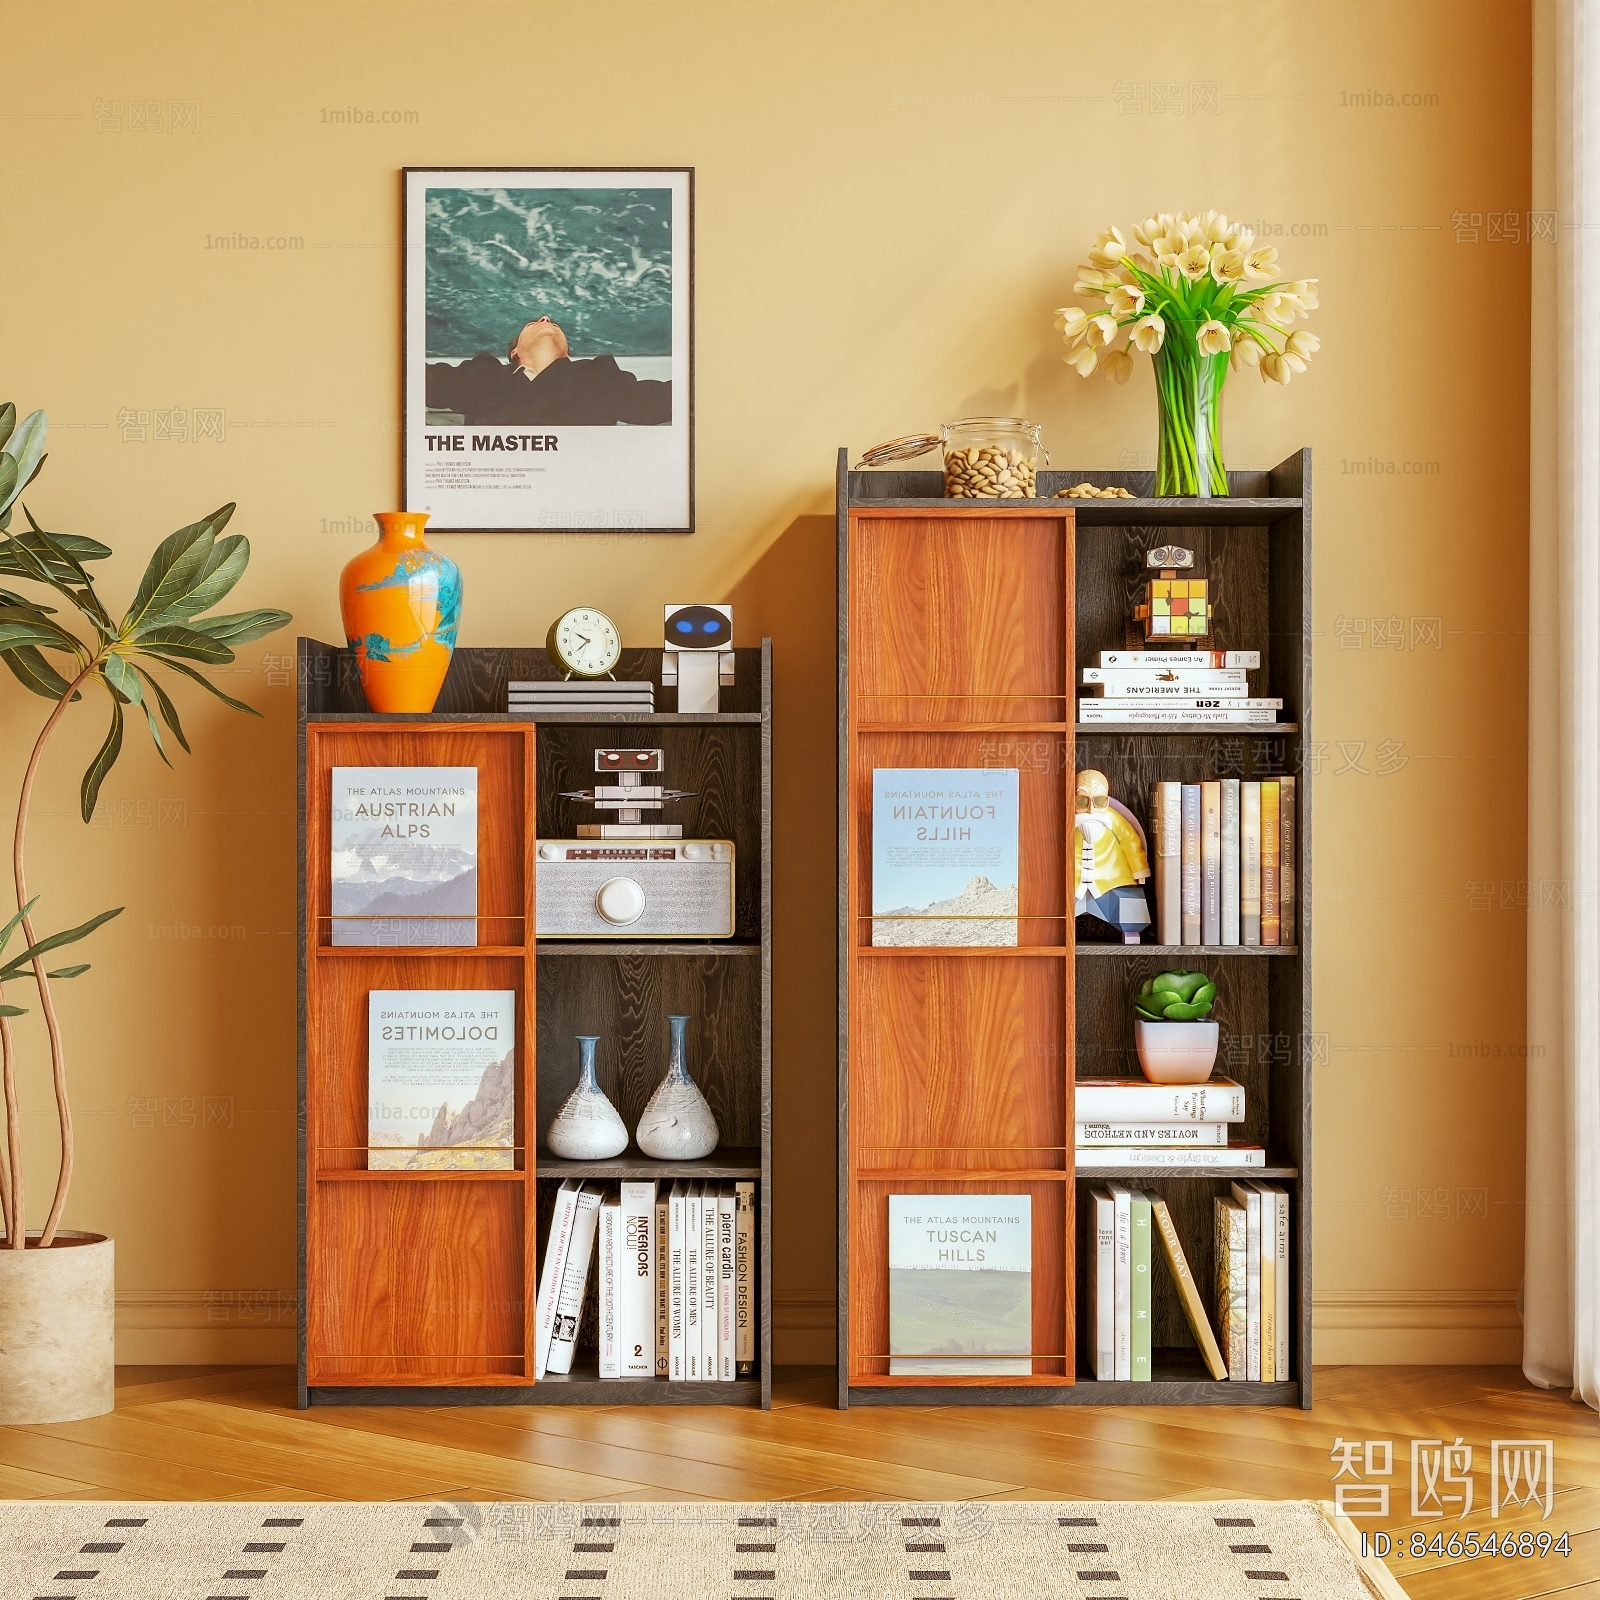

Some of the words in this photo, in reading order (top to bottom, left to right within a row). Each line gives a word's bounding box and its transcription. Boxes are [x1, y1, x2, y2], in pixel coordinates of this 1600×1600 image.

[425, 435, 465, 451] THE
[472, 435, 559, 451] MASTER
[1195, 700, 1221, 708] zen
[1212, 712, 1229, 720] Linda
[347, 788, 366, 796] THE
[370, 788, 402, 796] ATLAS
[406, 788, 465, 796] MOUNTAINS
[355, 803, 455, 817] AUSTRIAN
[380, 824, 430, 838] ALPS
[1182, 1100, 1190, 1112] Say
[1189, 1092, 1198, 1119] Paintings
[1084, 1130, 1132, 1139] METHODS
[1133, 1130, 1156, 1139] AND
[1157, 1130, 1199, 1139] MOVIES
[1129, 1153, 1165, 1163] Design
[1166, 1155, 1176, 1163] &
[1177, 1153, 1201, 1163] Style
[705, 1207, 715, 1226] THE
[904, 1216, 923, 1224] THE
[927, 1216, 958, 1224] ATLAS
[962, 1216, 1020, 1224] MOUNTAINS
[1278, 1204, 1289, 1227] safe
[720, 1213, 734, 1244] pierre
[556, 1231, 567, 1258] HOUSES
[705, 1227, 715, 1261] ALLURE
[926, 1231, 997, 1243] TUSCAN
[1158, 1210, 1176, 1248] YOUR
[1173, 1251, 1190, 1279] WAY
[637, 1216, 649, 1277] INTERIORS
[1117, 1241, 1130, 1264] flower
[554, 1257, 563, 1267] IN
[605, 1238, 614, 1278] ARCHITECTURE
[672, 1248, 681, 1265] THE
[689, 1248, 697, 1265] THE
[722, 1247, 734, 1280] cardin
[737, 1232, 748, 1282] FASHION
[938, 1249, 986, 1262] HILLS
[705, 1262, 715, 1274] OF
[549, 1266, 561, 1295] LONDON
[672, 1265, 681, 1296] ALLURE
[689, 1265, 697, 1296] ALLURE
[605, 1286, 614, 1298] THE
[705, 1275, 715, 1310] BEAUTY
[672, 1297, 681, 1308] OF
[689, 1297, 697, 1308] OF
[737, 1285, 748, 1328] DESIGN
[672, 1308, 681, 1339] WOMEN
[689, 1308, 697, 1326] MEN
[605, 1313, 614, 1342] CENTURY
[634, 1345, 643, 1357] 2
